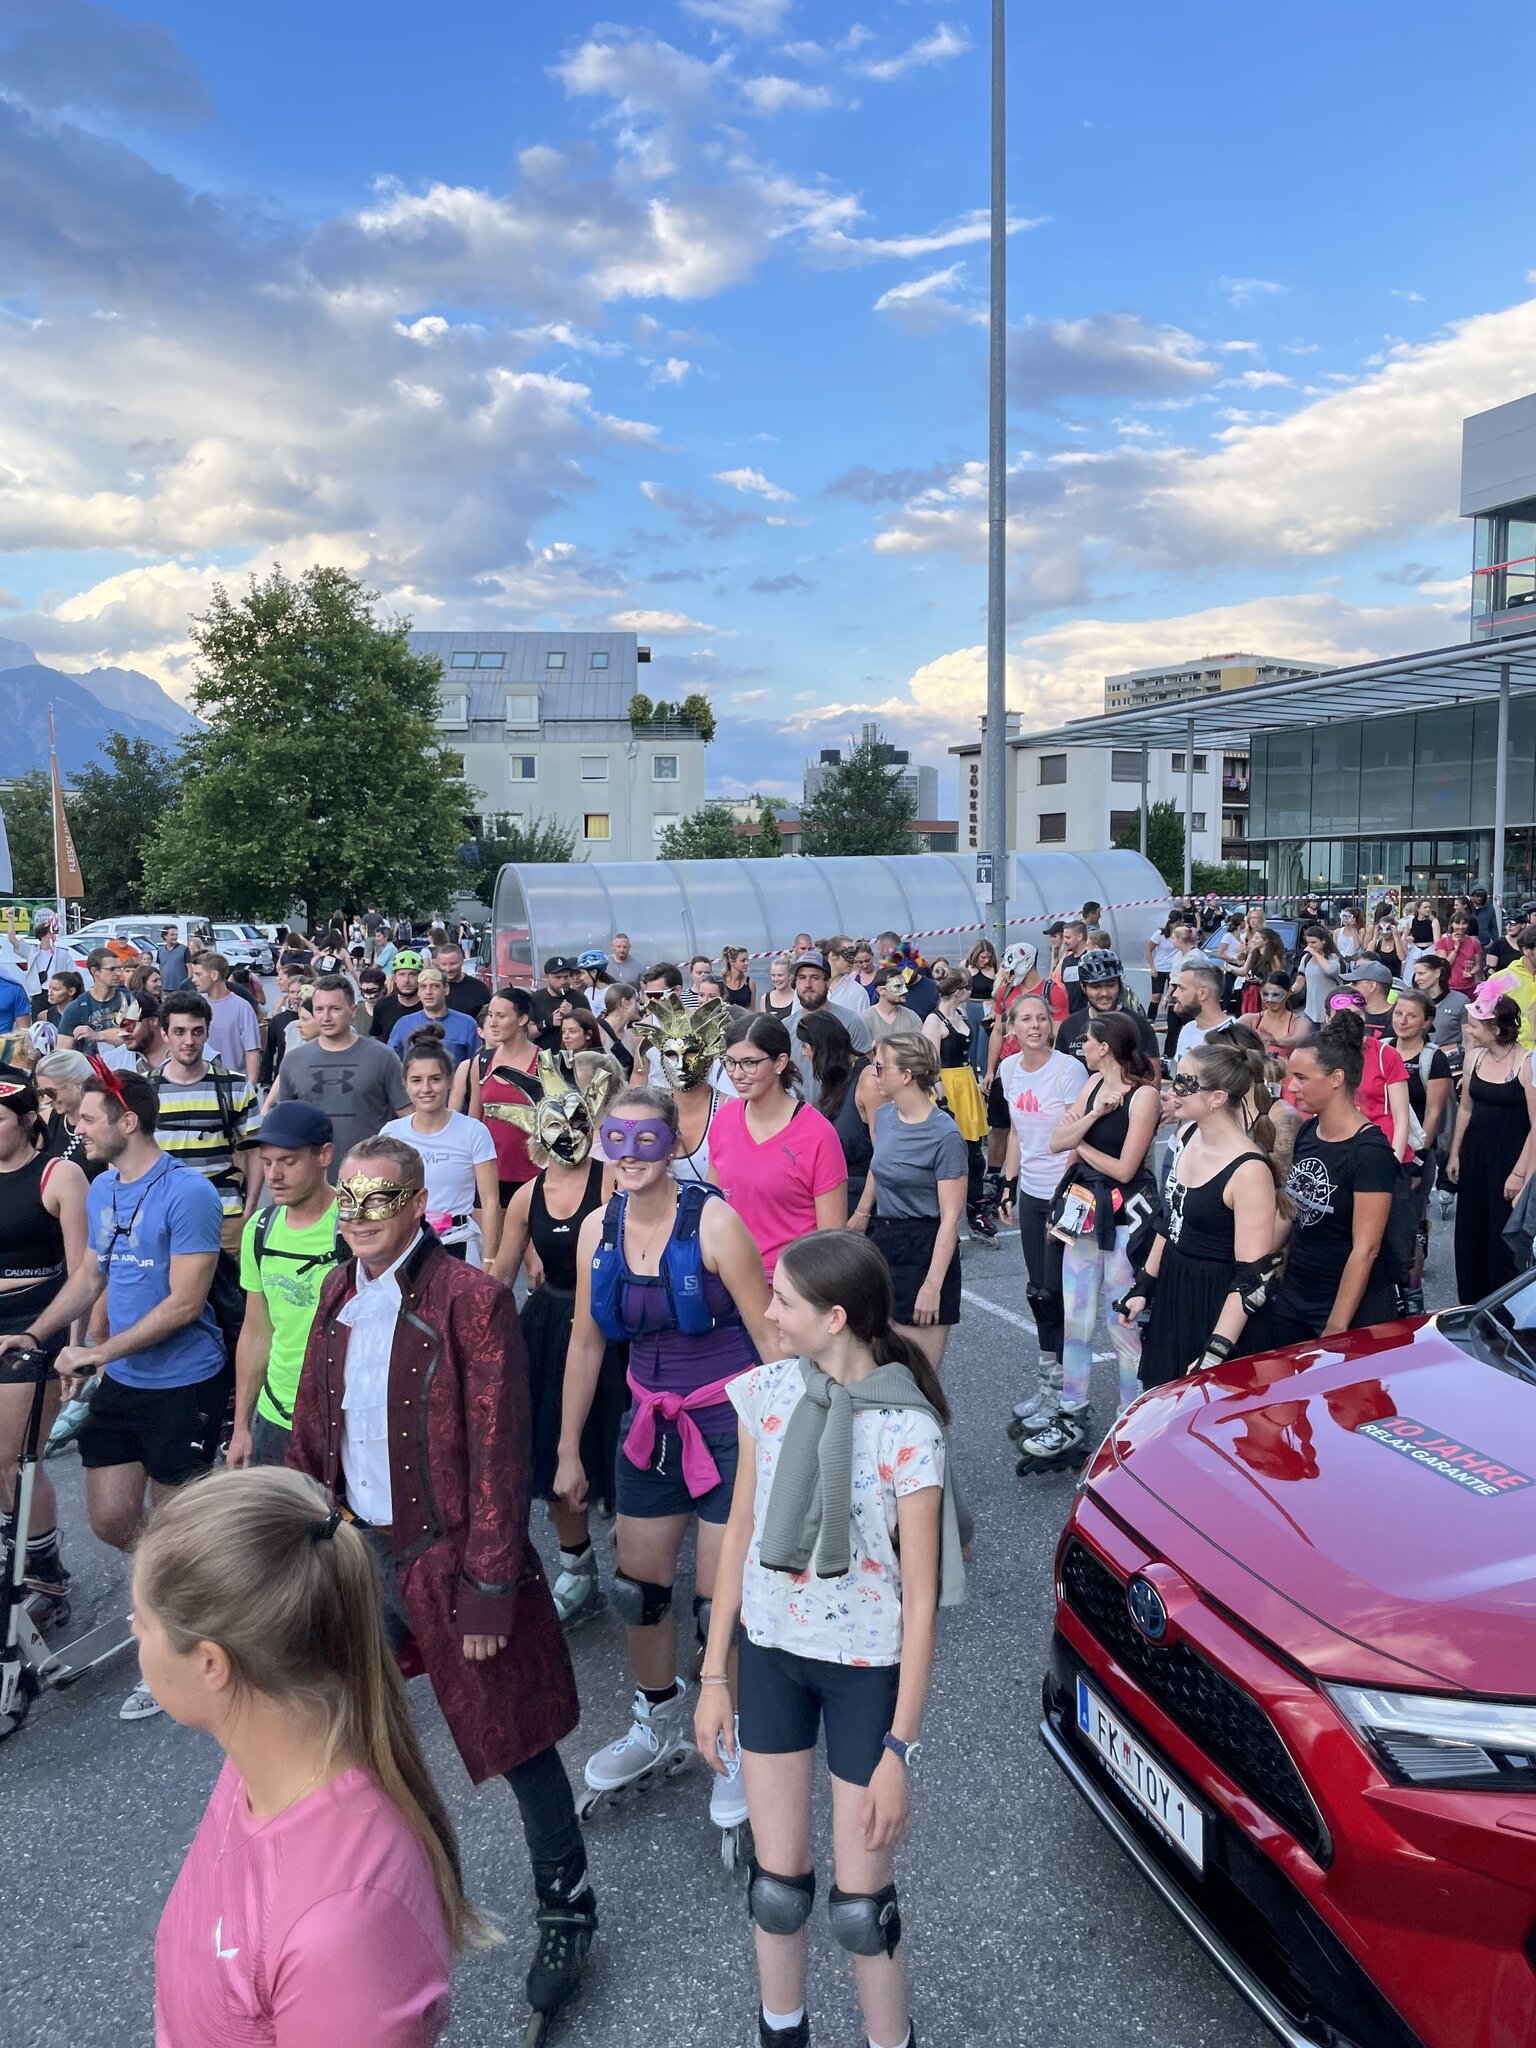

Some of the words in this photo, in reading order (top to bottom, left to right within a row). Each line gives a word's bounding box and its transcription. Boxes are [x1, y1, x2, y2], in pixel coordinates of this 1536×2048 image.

[969, 764, 979, 848] DÖDERER
[1288, 1160, 1317, 1180] UNSET
[4, 1268, 34, 1277] CALVIN
[1360, 1424, 1416, 1452] RELAX
[1411, 1450, 1500, 1496] GARANTIE
[1381, 1418, 1425, 1437] 10
[1413, 1438, 1530, 1490] JAHRE
[1098, 1708, 1120, 1766] FK
[1133, 1750, 1171, 1820] TOY
[1177, 1800, 1185, 1840] 1
